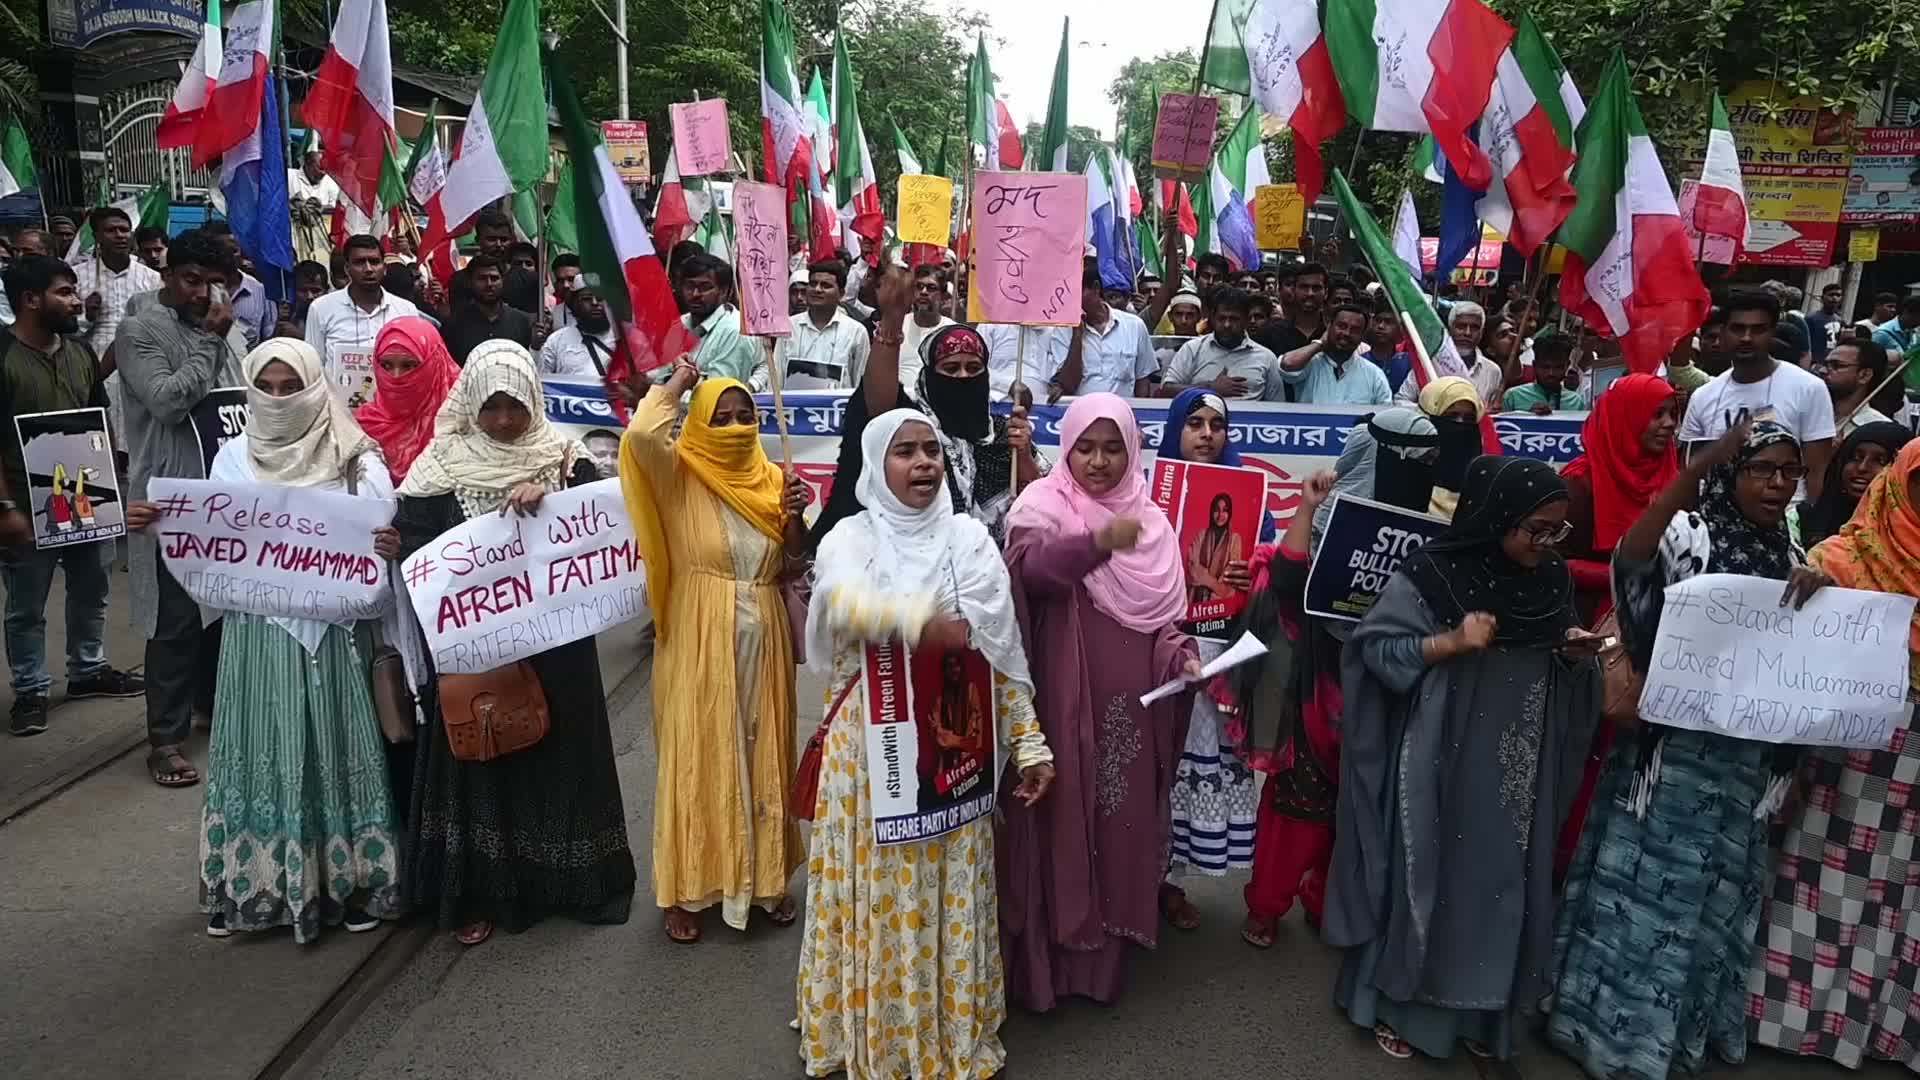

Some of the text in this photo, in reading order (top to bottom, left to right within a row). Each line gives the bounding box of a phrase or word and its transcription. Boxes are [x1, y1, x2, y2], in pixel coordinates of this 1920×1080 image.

[1158, 464, 1175, 506] Fatima
[161, 532, 378, 586] JAVED MUHAMMAD
[303, 590, 326, 616] OF
[437, 570, 534, 634] AFREN
[1192, 602, 1225, 618] Afreen
[437, 606, 576, 673] FRATERNITY
[1196, 618, 1225, 634] Fatima
[1660, 634, 1905, 704] Javed Muhammad
[879, 680, 897, 721] Afreen
[1727, 695, 1793, 734] PARTY
[1794, 706, 1823, 737] OF
[1823, 708, 1887, 743] INDIA
[881, 725, 901, 798] #StandWith
[945, 757, 977, 785] Afreen
[952, 773, 980, 800] Fatima
[877, 817, 920, 840] WELFARE
[921, 813, 947, 836] PARTY
[948, 807, 959, 825] OF
